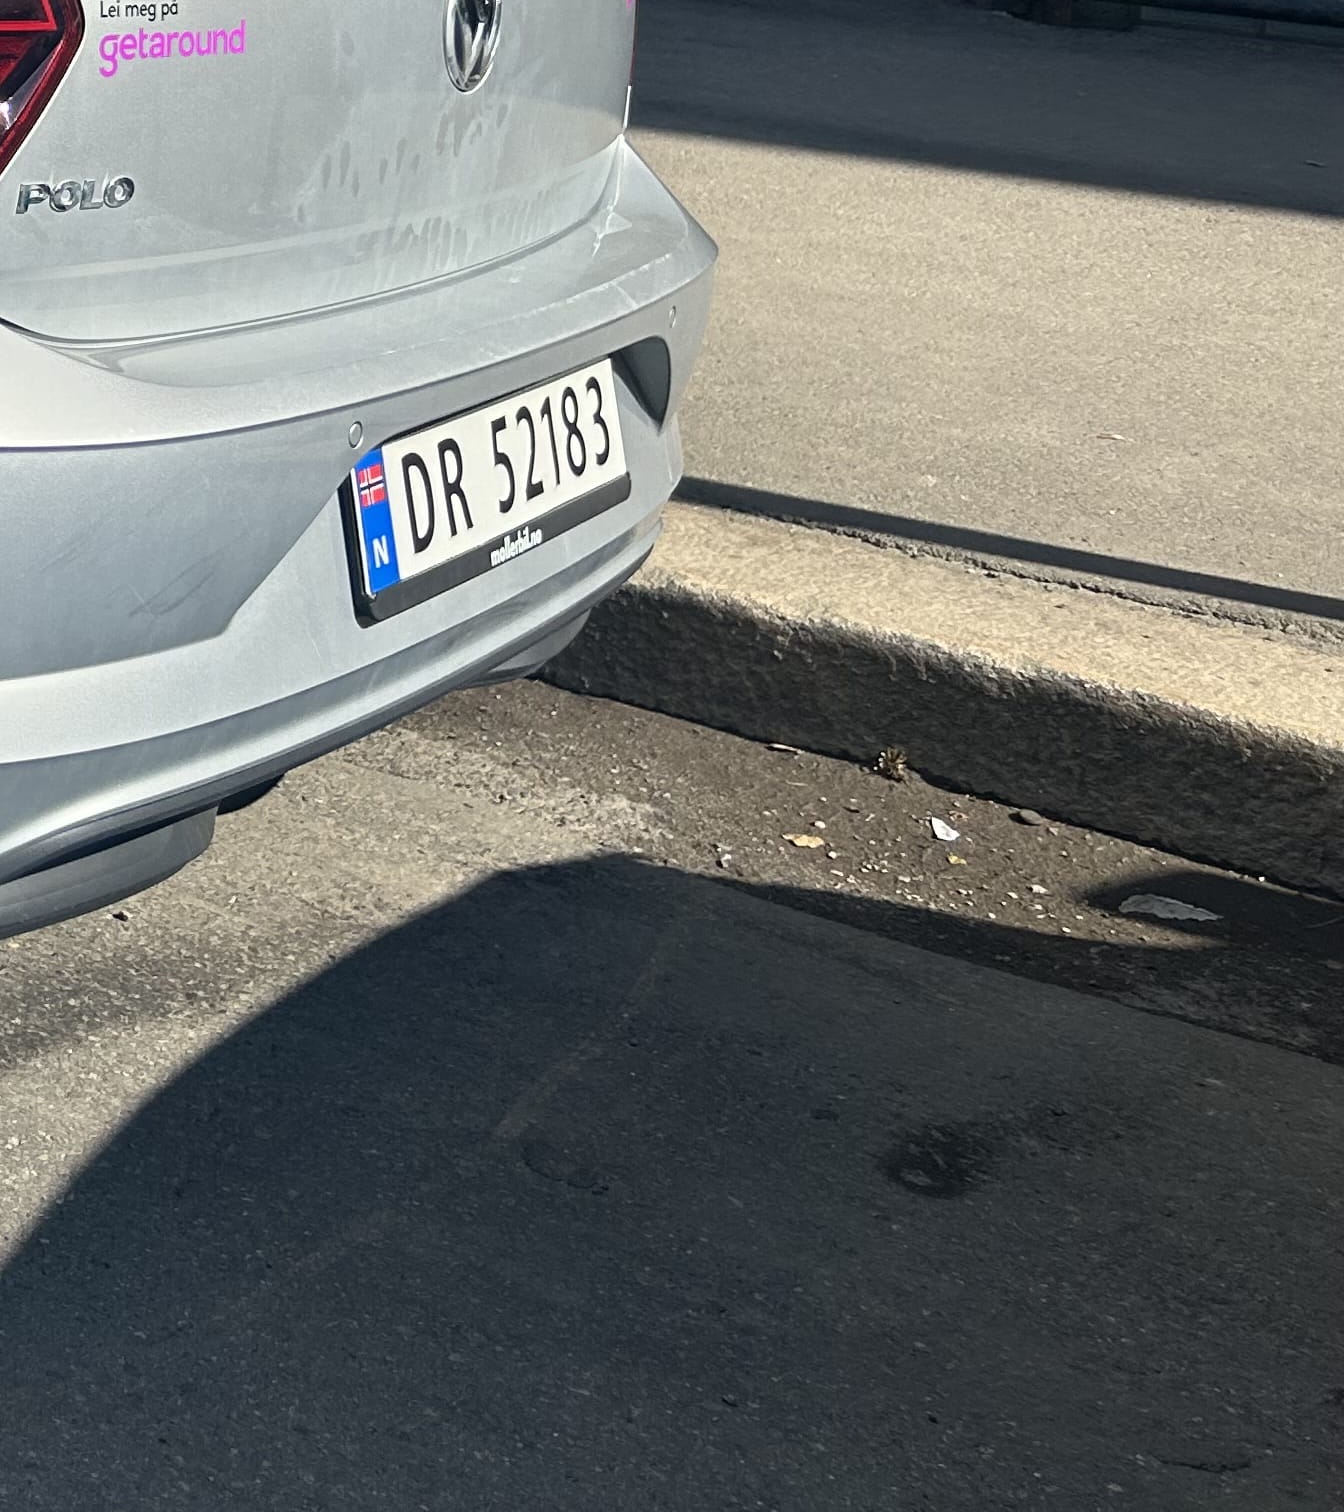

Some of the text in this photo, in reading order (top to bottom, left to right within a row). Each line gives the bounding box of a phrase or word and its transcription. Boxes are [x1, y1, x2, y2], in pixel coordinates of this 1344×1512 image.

[100, 0, 120, 18] Lei
[125, 3, 156, 22] meg
[98, 19, 246, 78] getaround
[15, 177, 135, 214] POLO
[401, 376, 610, 554] DR 52183
[372, 534, 389, 569] N
